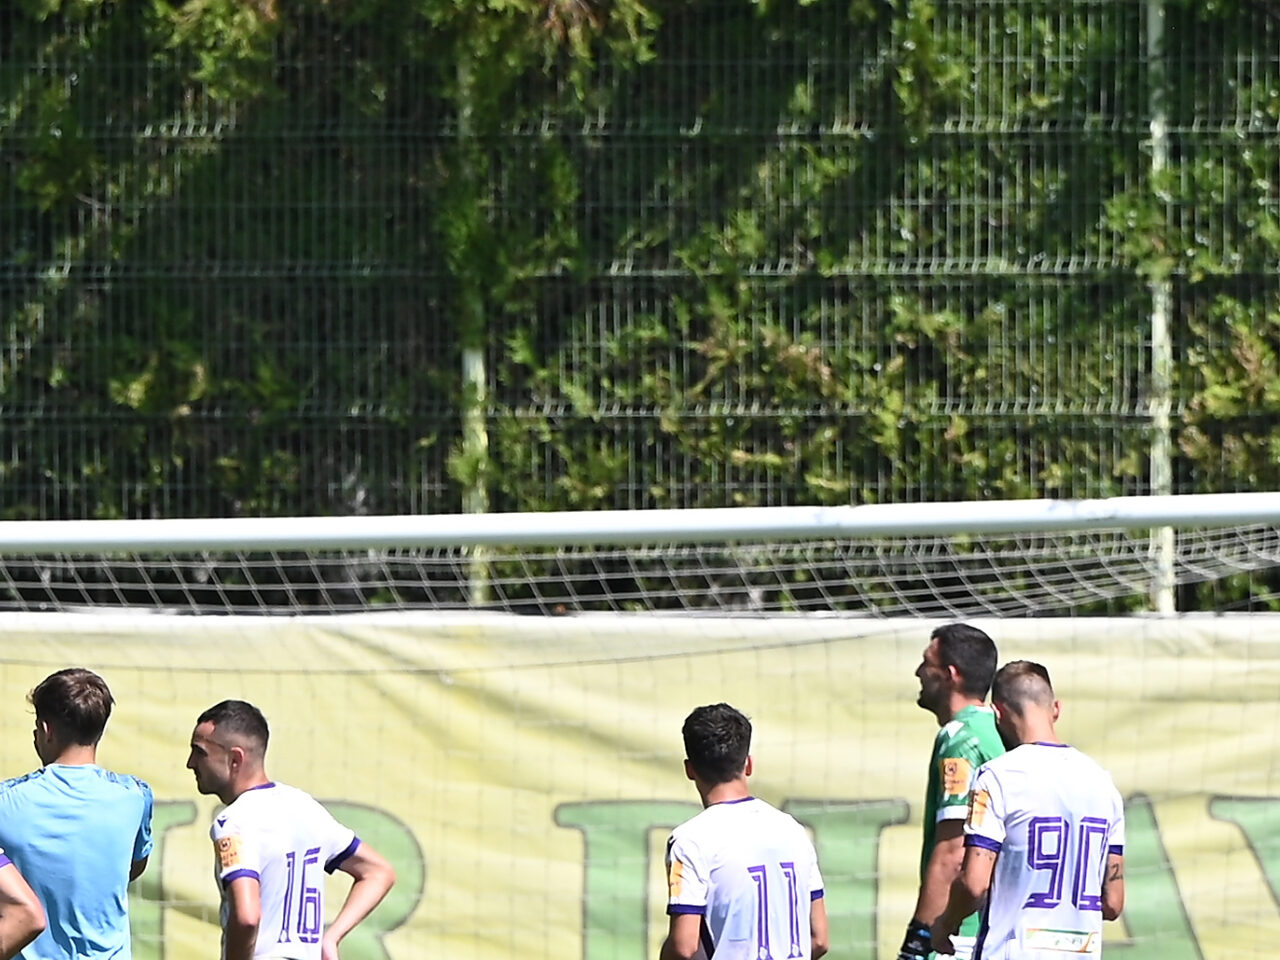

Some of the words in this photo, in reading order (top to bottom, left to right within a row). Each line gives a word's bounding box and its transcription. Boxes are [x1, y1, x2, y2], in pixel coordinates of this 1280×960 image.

[277, 847, 321, 944] 16
[748, 861, 804, 960] 11
[1022, 816, 1111, 911] 90
